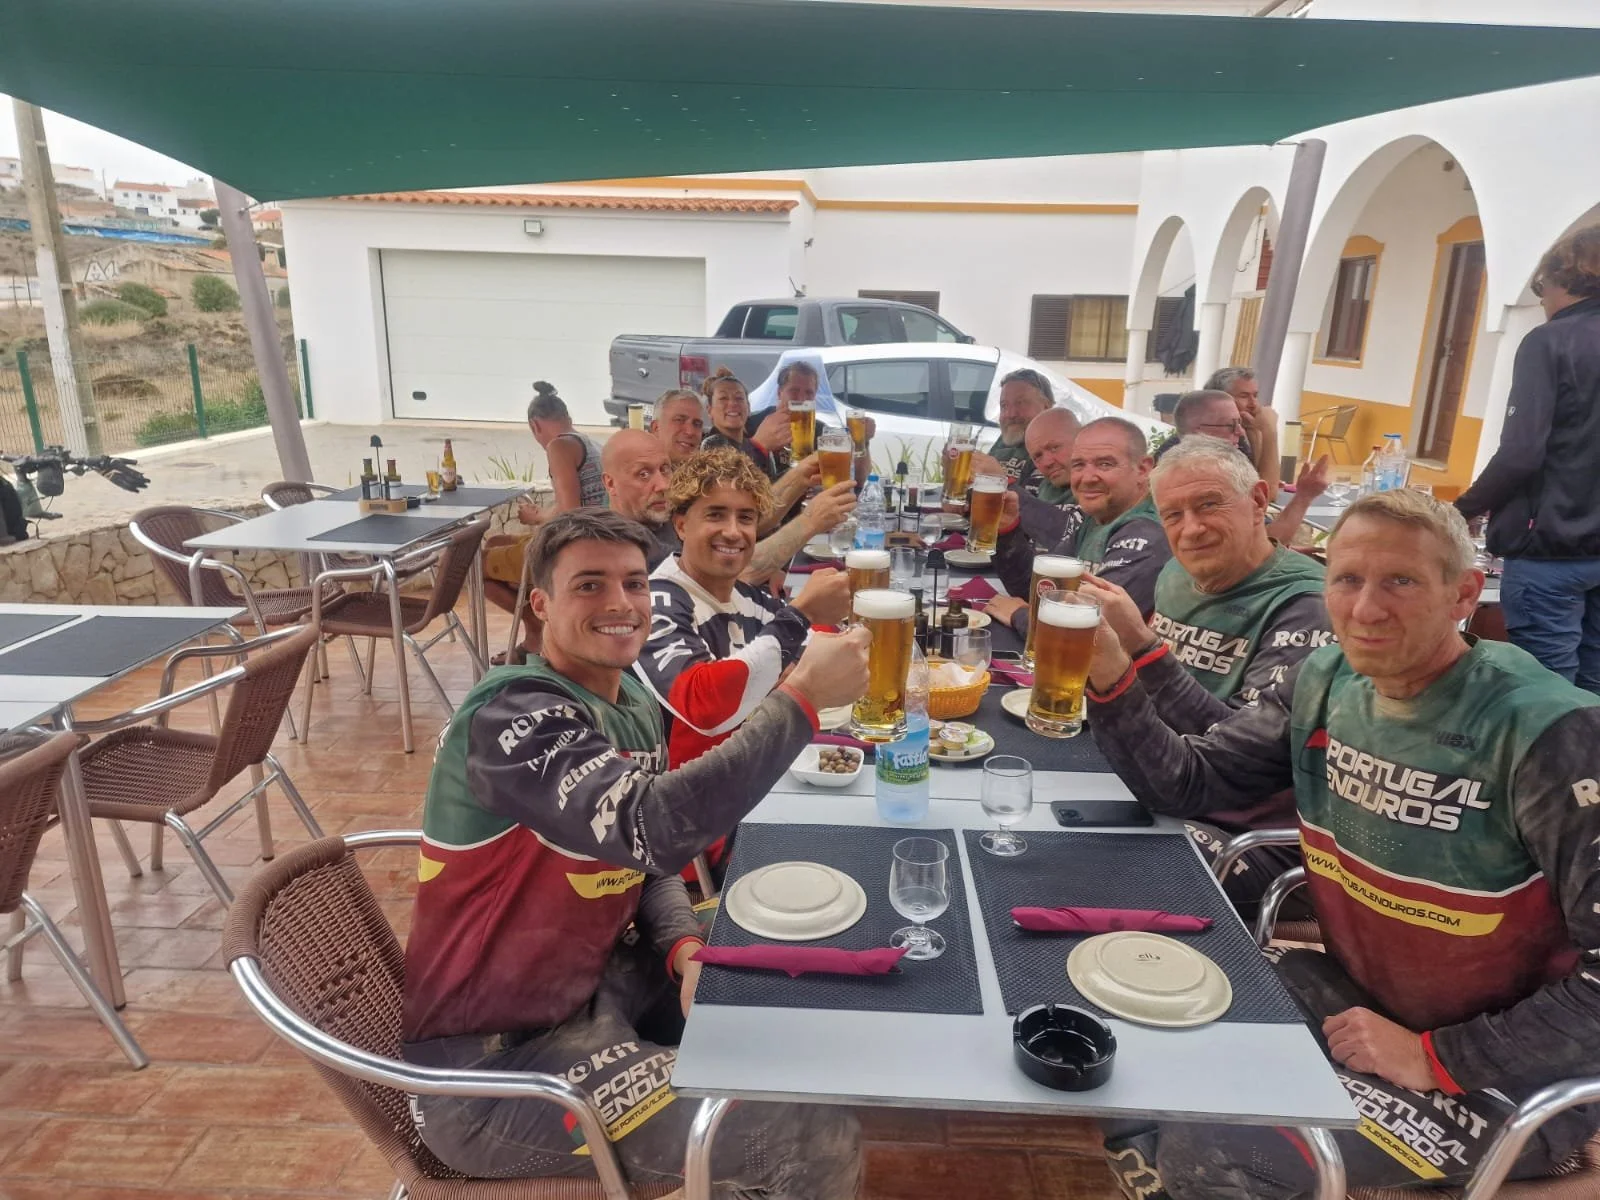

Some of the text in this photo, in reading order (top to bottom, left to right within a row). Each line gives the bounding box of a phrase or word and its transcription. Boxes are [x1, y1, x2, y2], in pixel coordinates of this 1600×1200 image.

[1151, 612, 1249, 659] PORTUGAL
[1160, 636, 1235, 675] UROS
[1326, 737, 1491, 810] PORTUGAL
[1326, 765, 1463, 832] ENDUROS
[557, 1041, 640, 1084] OKiT
[593, 1049, 678, 1107] PORTU
